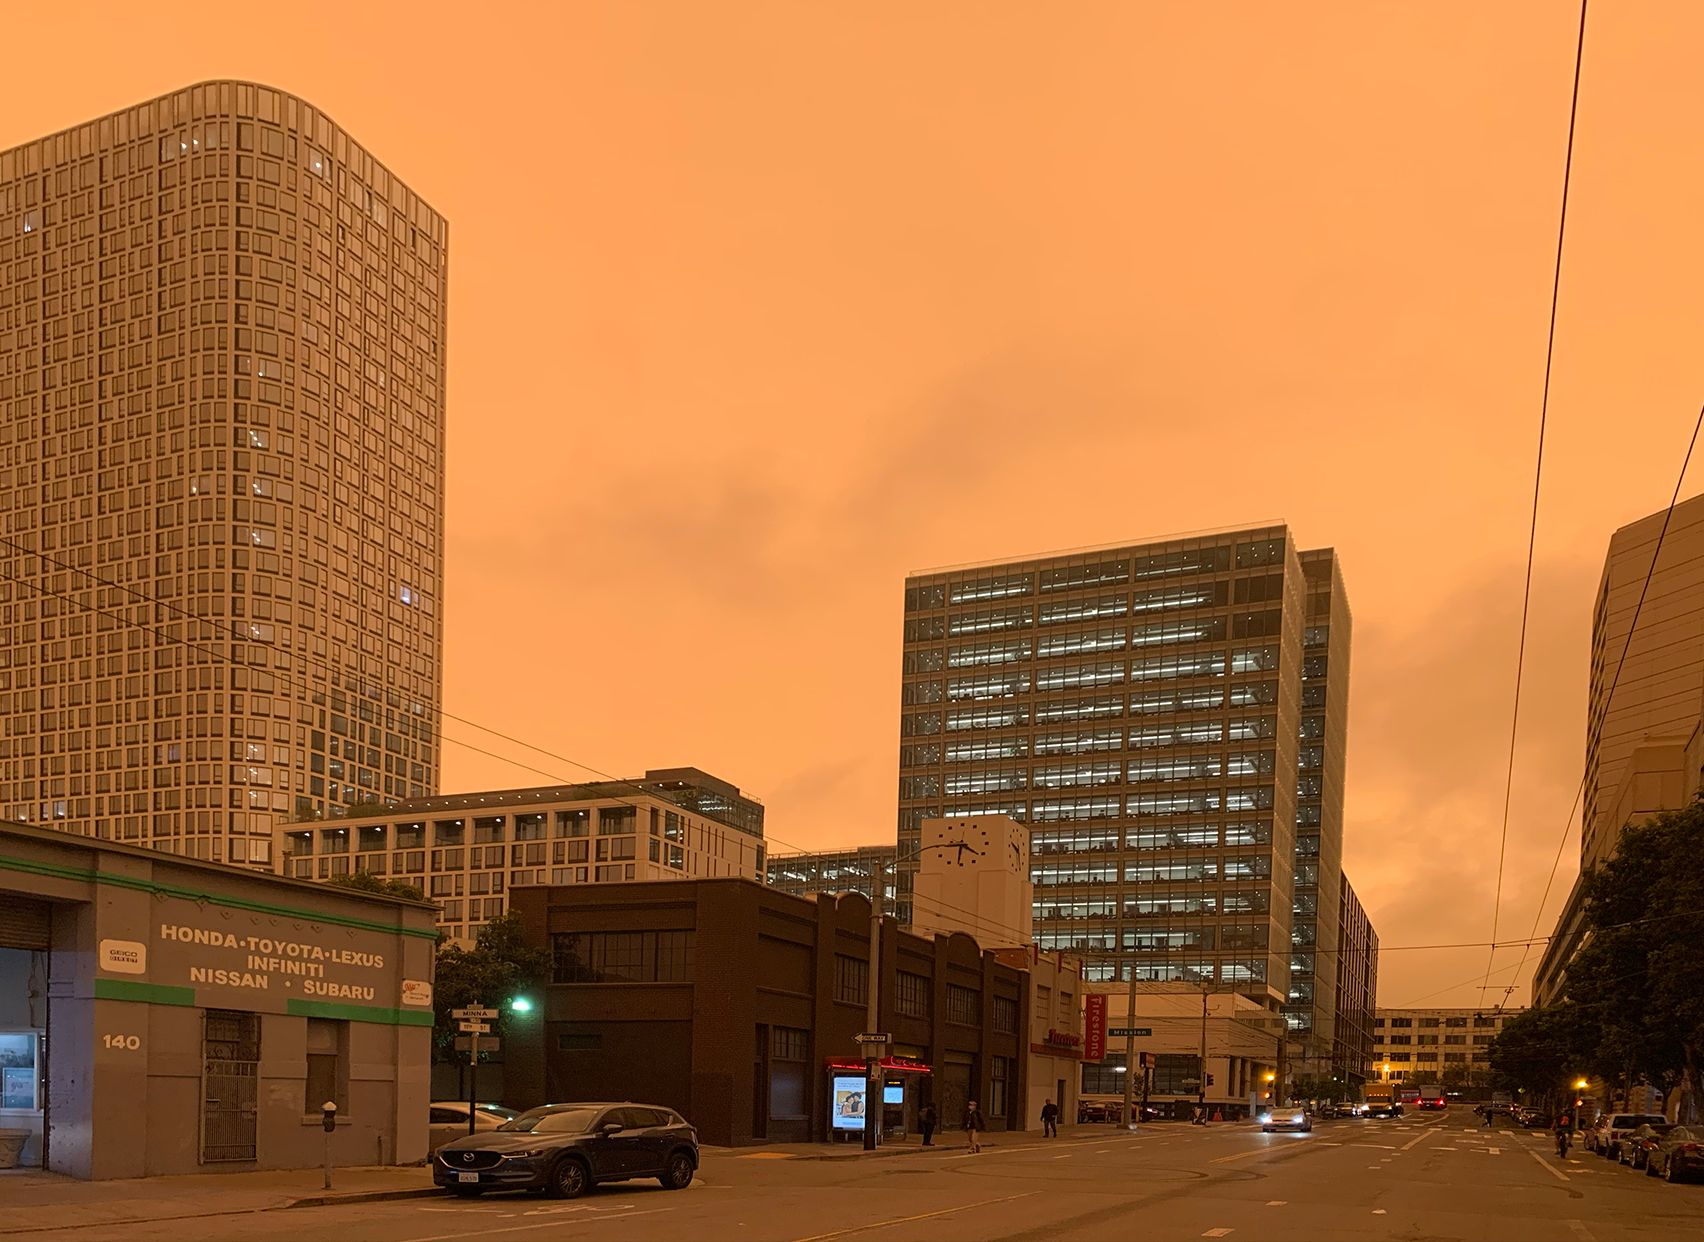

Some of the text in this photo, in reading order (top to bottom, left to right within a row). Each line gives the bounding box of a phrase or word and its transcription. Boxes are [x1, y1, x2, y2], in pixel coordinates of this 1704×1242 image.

[160, 924, 384, 969] HONDA TOYOTA LEXUS
[247, 955, 324, 978] INFINITI
[190, 967, 375, 1000] NISSAN SUBARU
[103, 1034, 141, 1050] 140
